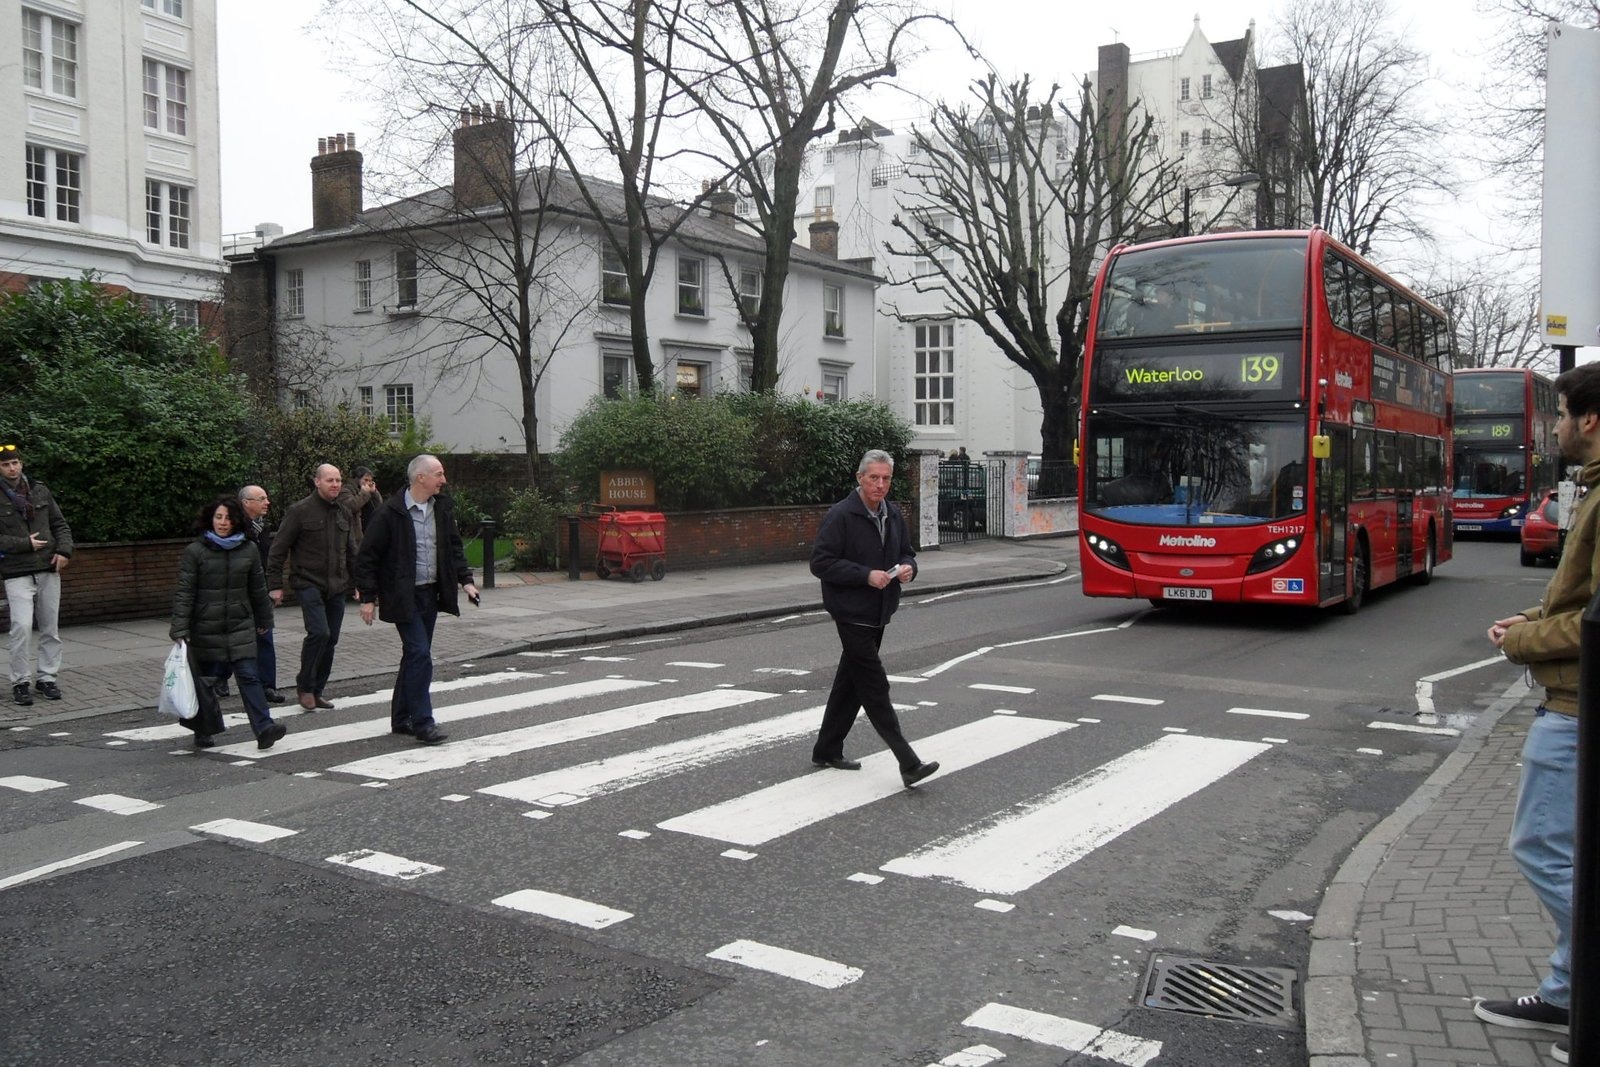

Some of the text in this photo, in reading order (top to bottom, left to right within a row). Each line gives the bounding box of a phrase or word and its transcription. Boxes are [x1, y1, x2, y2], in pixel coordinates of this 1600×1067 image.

[1241, 355, 1279, 382] 139
[1125, 366, 1203, 384] Waterloo
[1491, 424, 1511, 437] 189
[609, 477, 645, 486] ABBEY
[609, 489, 647, 499] HOUSE
[1267, 525, 1304, 534] TEH1217
[1160, 534, 1216, 547] Metroline
[1168, 589, 1188, 598] LK61
